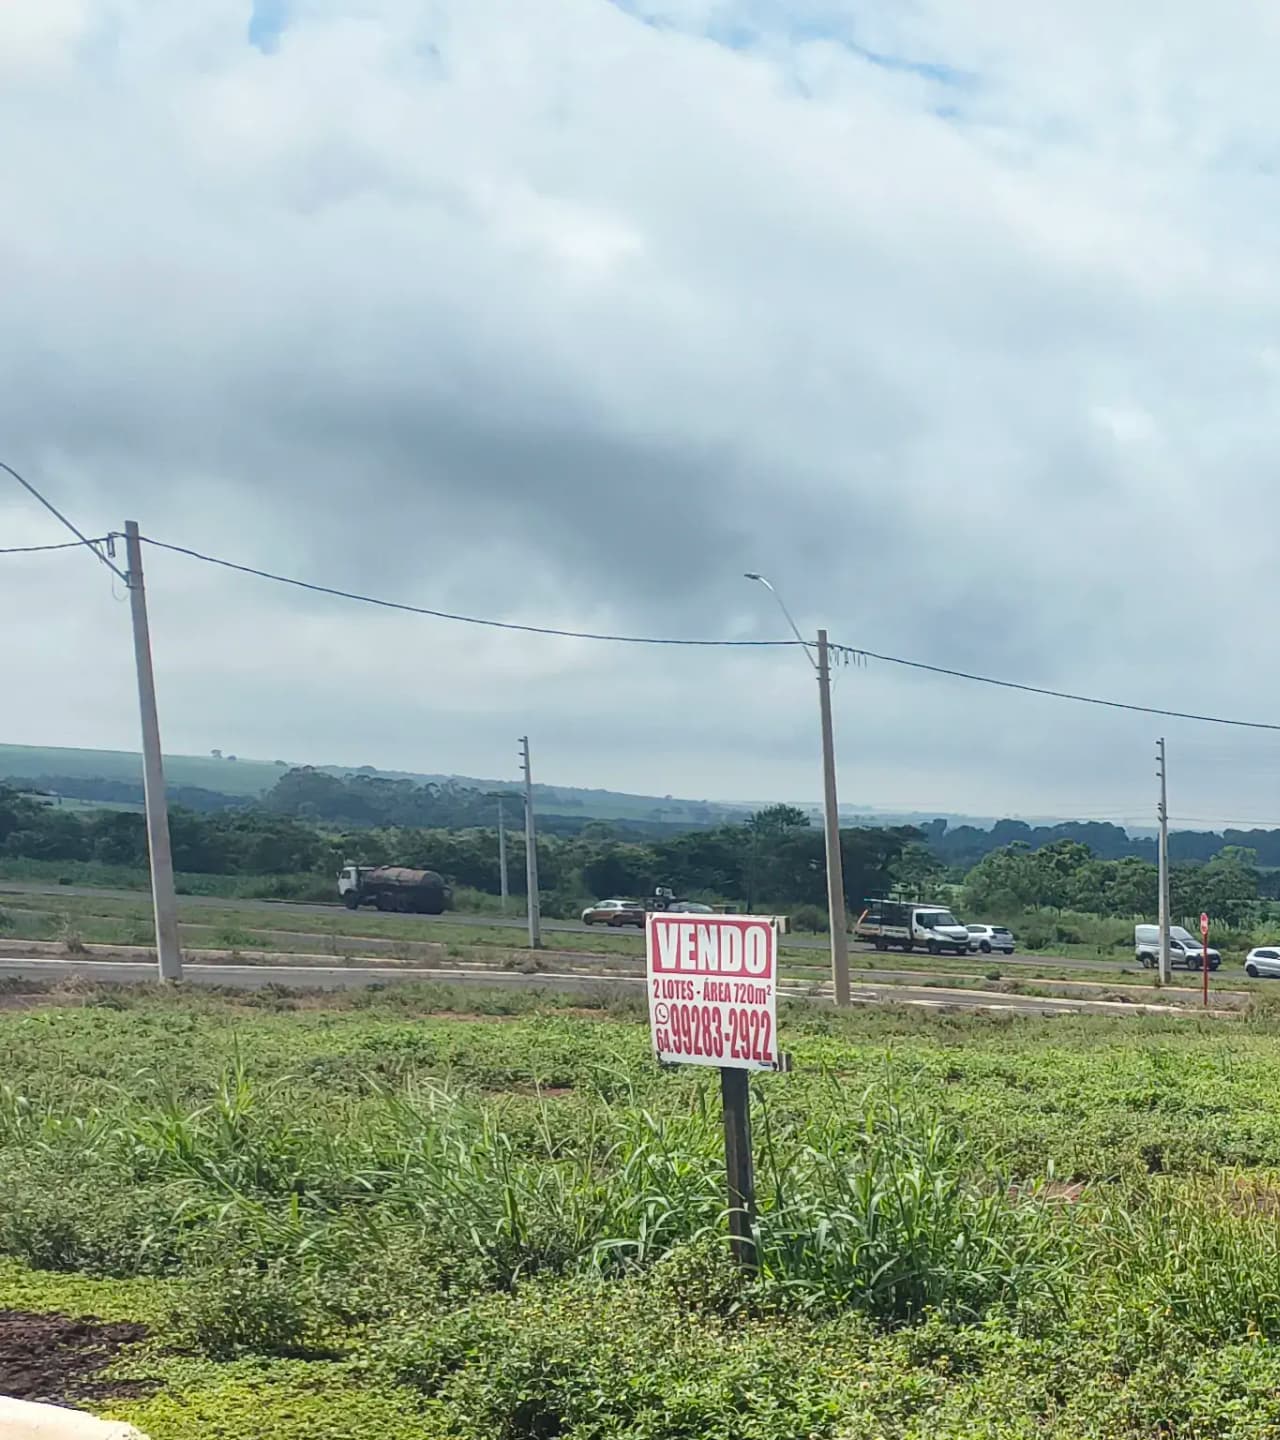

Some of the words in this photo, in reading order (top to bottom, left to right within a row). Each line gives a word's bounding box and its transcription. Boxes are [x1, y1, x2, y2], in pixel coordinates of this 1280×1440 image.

[656, 922, 767, 974] VENDO
[653, 978, 660, 999] 2
[662, 979, 694, 1001] LOTES
[703, 977, 732, 1002] ÁREA
